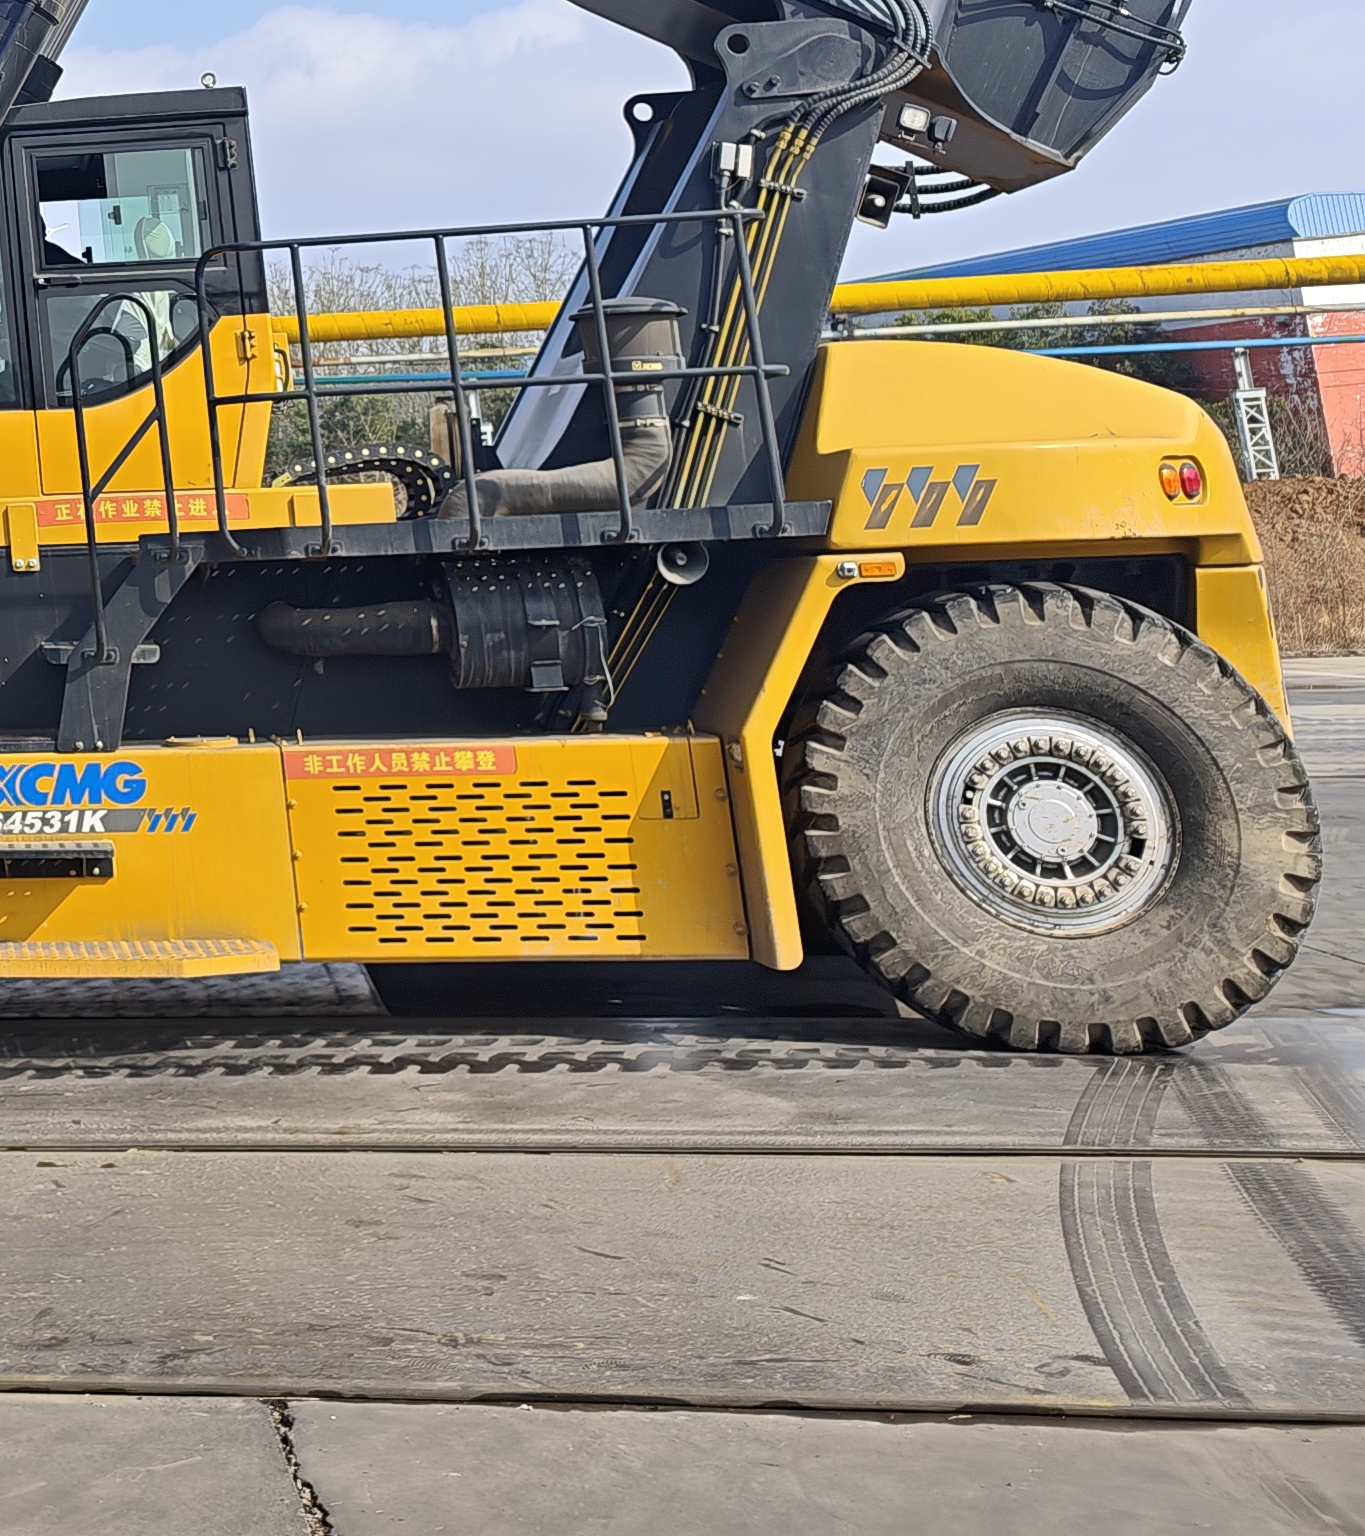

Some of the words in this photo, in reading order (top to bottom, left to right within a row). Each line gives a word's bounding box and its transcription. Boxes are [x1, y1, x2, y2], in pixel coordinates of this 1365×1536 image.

[302, 749, 497, 775] 非工作人员禁止攀登
